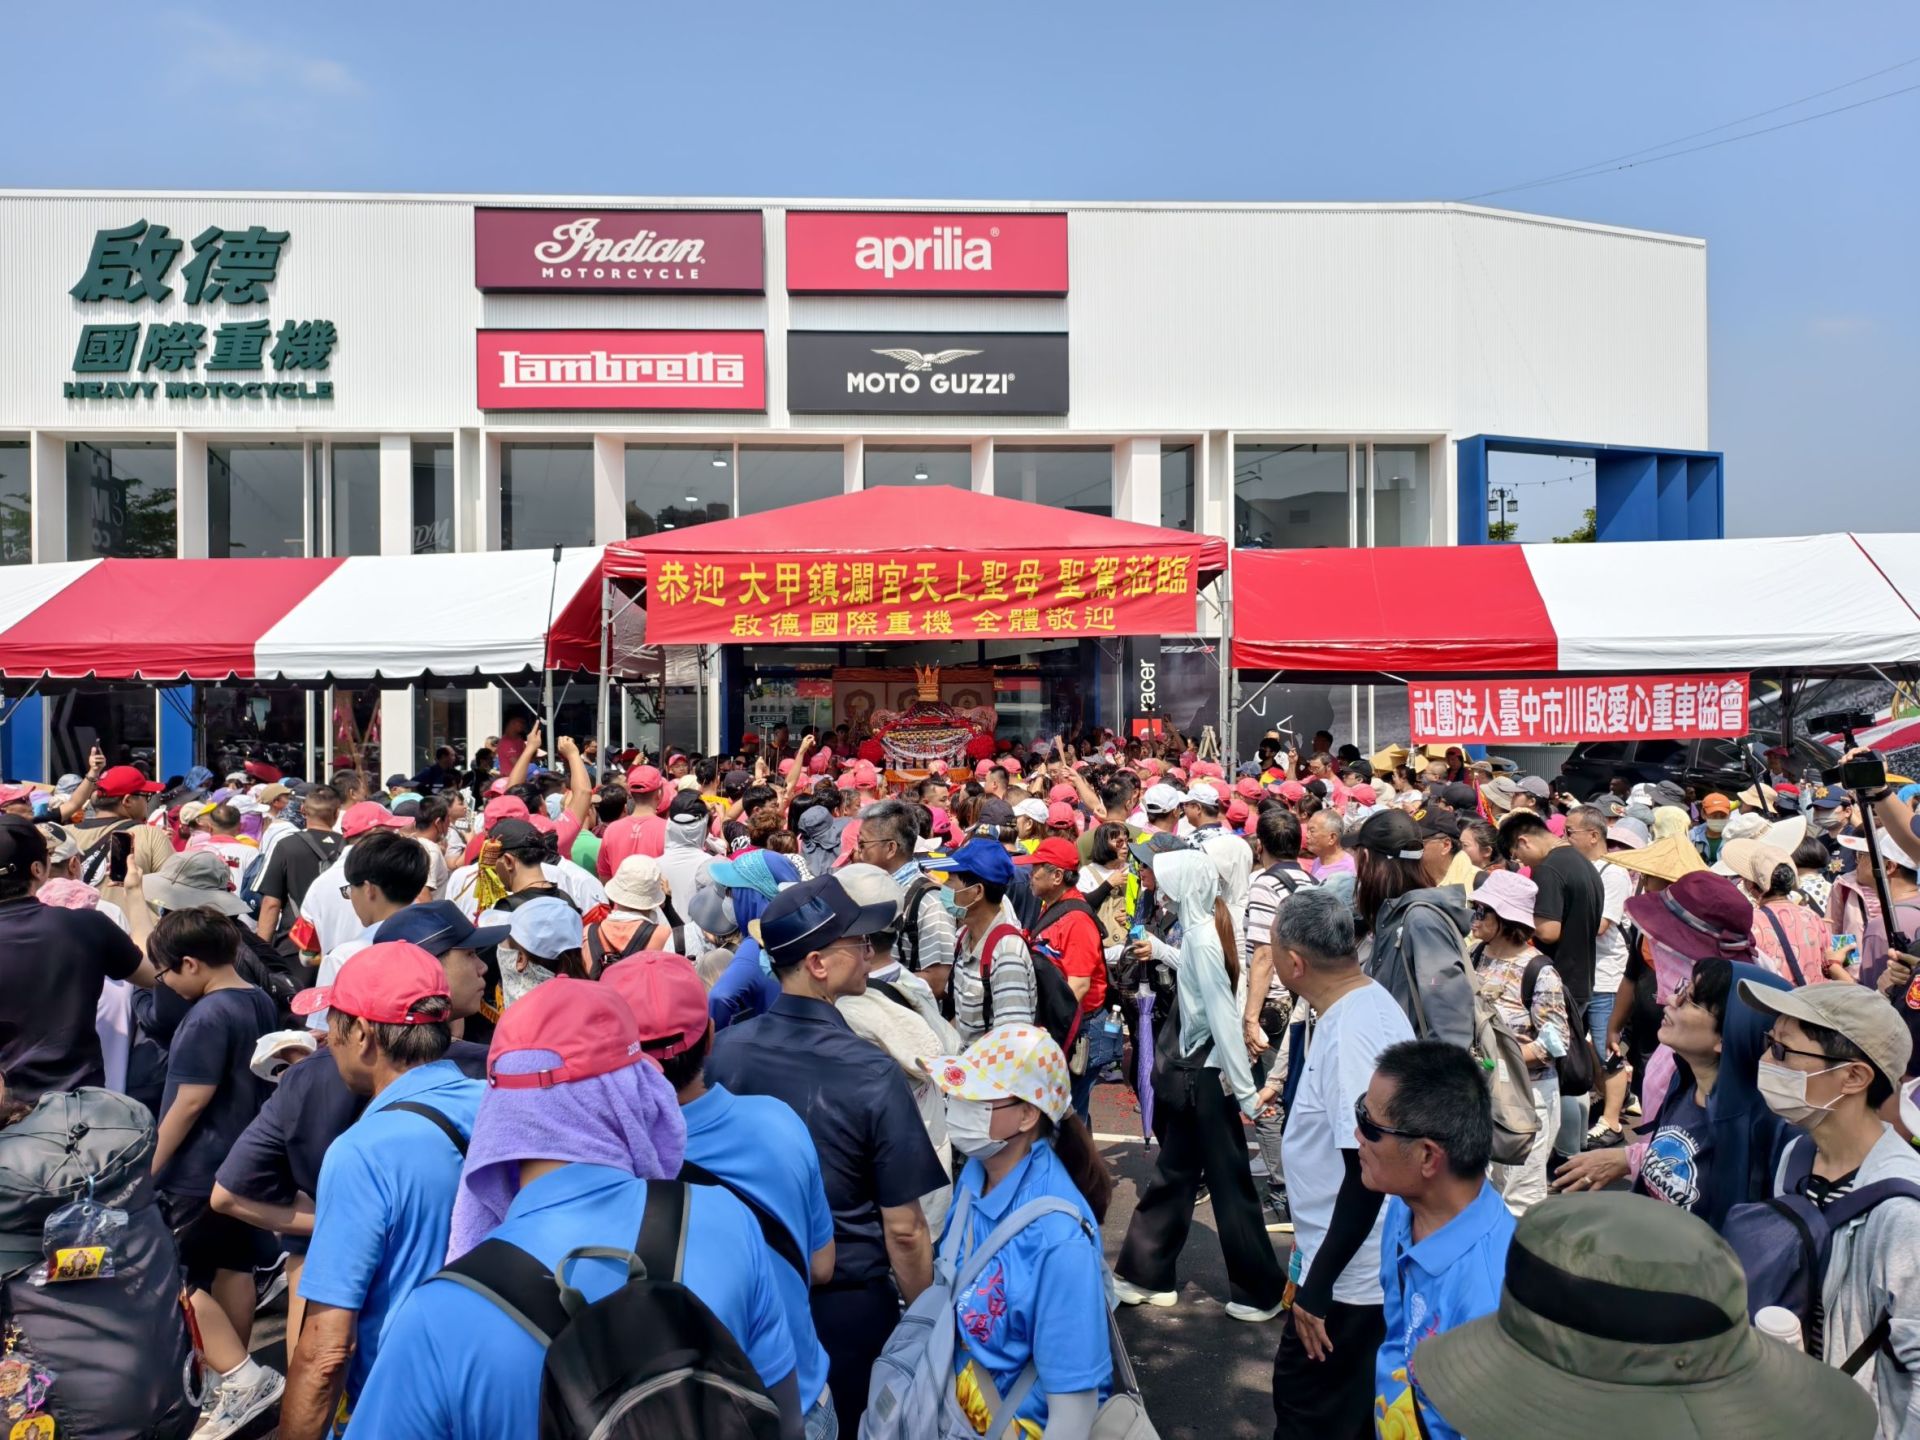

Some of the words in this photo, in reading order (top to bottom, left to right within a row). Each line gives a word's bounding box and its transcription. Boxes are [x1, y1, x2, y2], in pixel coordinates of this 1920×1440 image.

[69, 218, 290, 304] 啟德
[534, 218, 705, 264] Indian
[542, 267, 700, 280] MOTORCYCLE
[72, 320, 338, 373] 國際重機
[498, 350, 744, 388] Lambretta
[63, 382, 158, 399] HEAVY
[165, 382, 334, 400] MOTOCYCLE
[847, 372, 920, 393] MOTO
[656, 561, 727, 607] 恭迎
[738, 558, 1045, 606] 大甲鎮瀾宮天上聖母
[730, 609, 954, 637] 啟德國際重機
[971, 606, 1116, 633] 全體敬迎
[1140, 658, 1155, 712] racer
[1413, 679, 1744, 737] 社團法人臺中市川啟愛心重車協會
